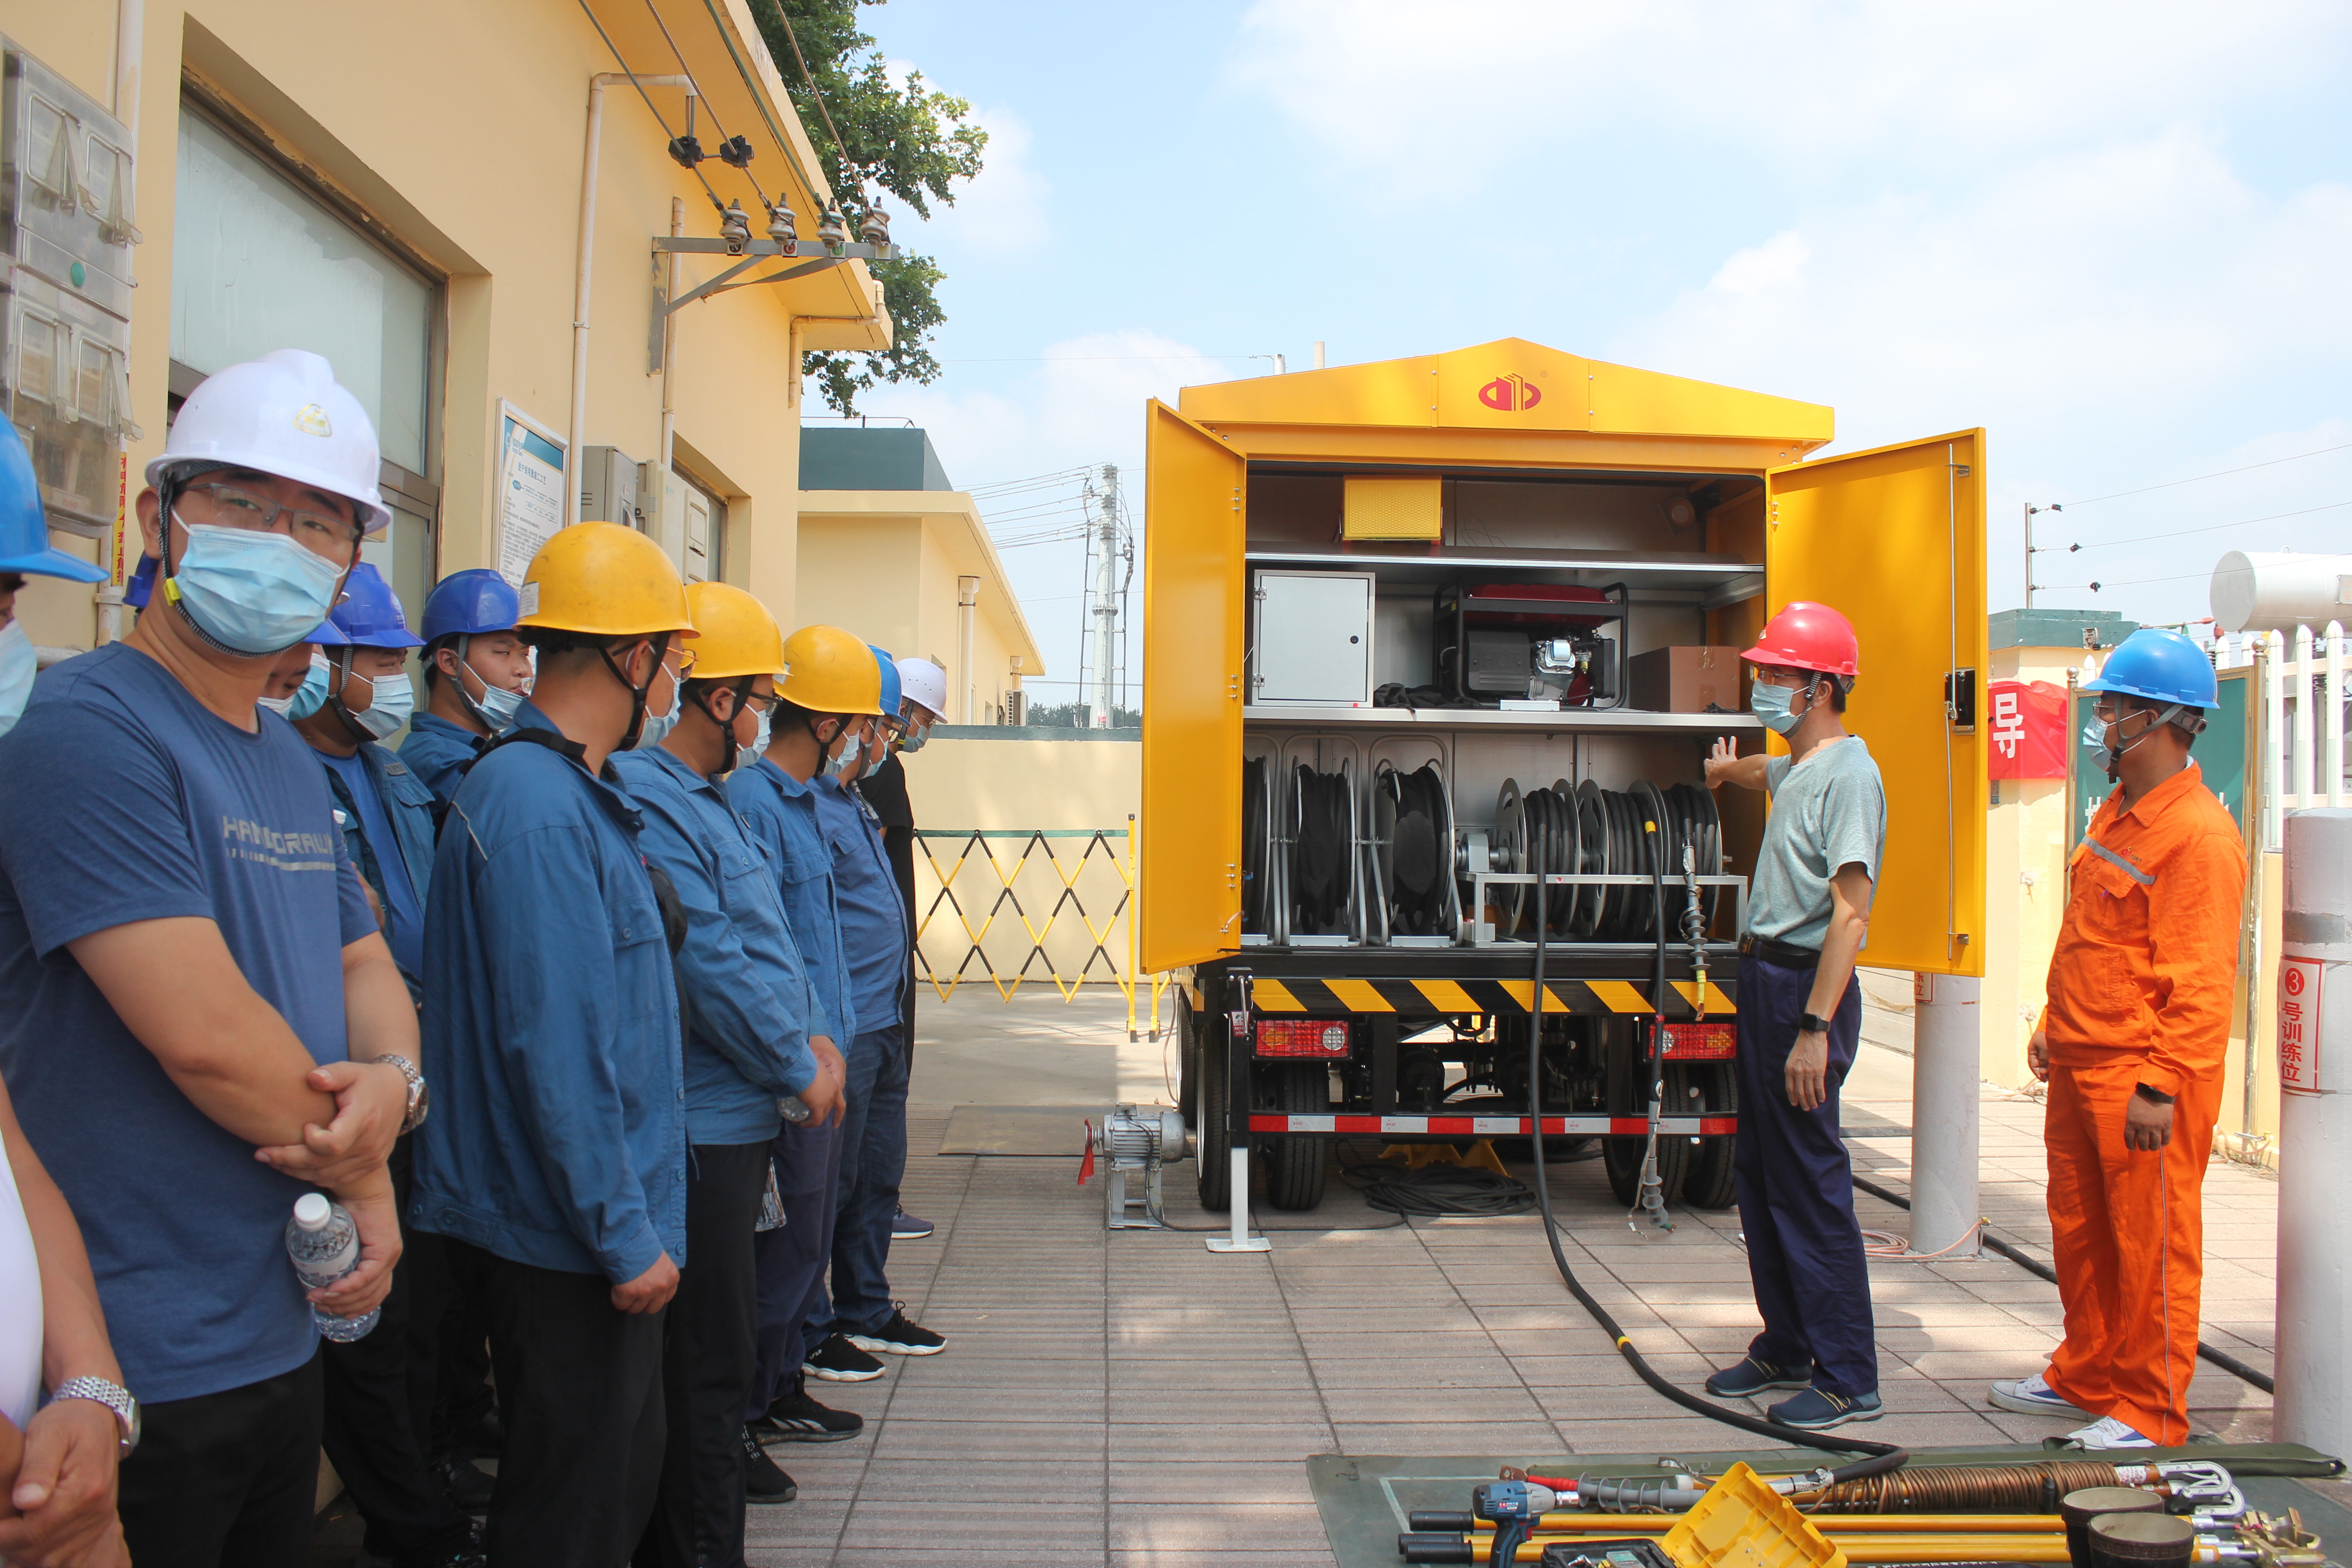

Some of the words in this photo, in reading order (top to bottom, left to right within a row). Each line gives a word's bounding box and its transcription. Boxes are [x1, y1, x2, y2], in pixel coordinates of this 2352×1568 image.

[1993, 692, 2025, 759] 导
[2289, 971, 2299, 993] 3
[2281, 1001, 2303, 1082] 号训练位
